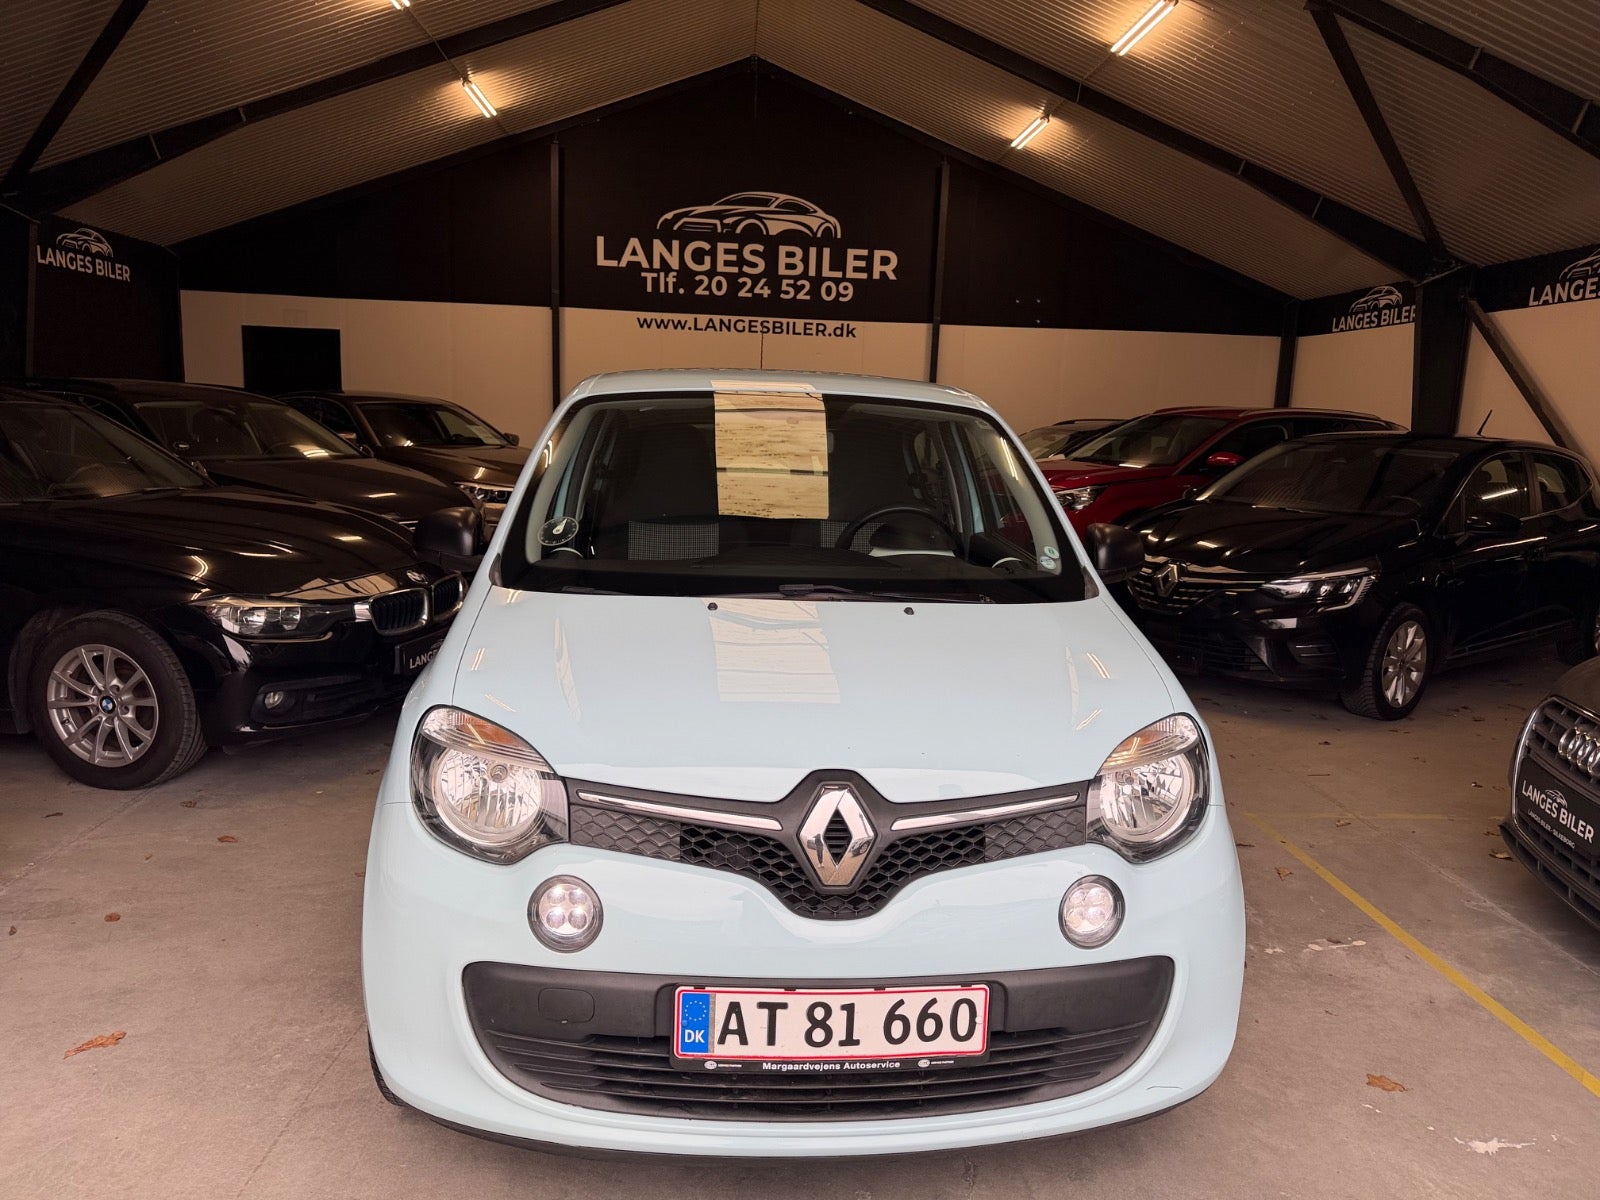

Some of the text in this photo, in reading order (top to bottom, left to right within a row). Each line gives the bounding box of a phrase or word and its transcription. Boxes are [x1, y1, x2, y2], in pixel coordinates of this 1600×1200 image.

[37, 244, 131, 282] LANGES BILER
[596, 235, 898, 280] LANGES BILER
[641, 272, 854, 302] Tlf. 20 24 52 09
[1529, 277, 1600, 306] LANGE
[636, 316, 857, 338] www.LANGESBILER.dk
[1332, 311, 1378, 332] LANGES
[409, 649, 438, 669] LANGE
[1522, 780, 1594, 844] LANGES BILER
[684, 1029, 705, 1043] DK
[717, 997, 978, 1048] AT 81 660
[762, 1060, 901, 1072] Margaardvejens Autoservice
